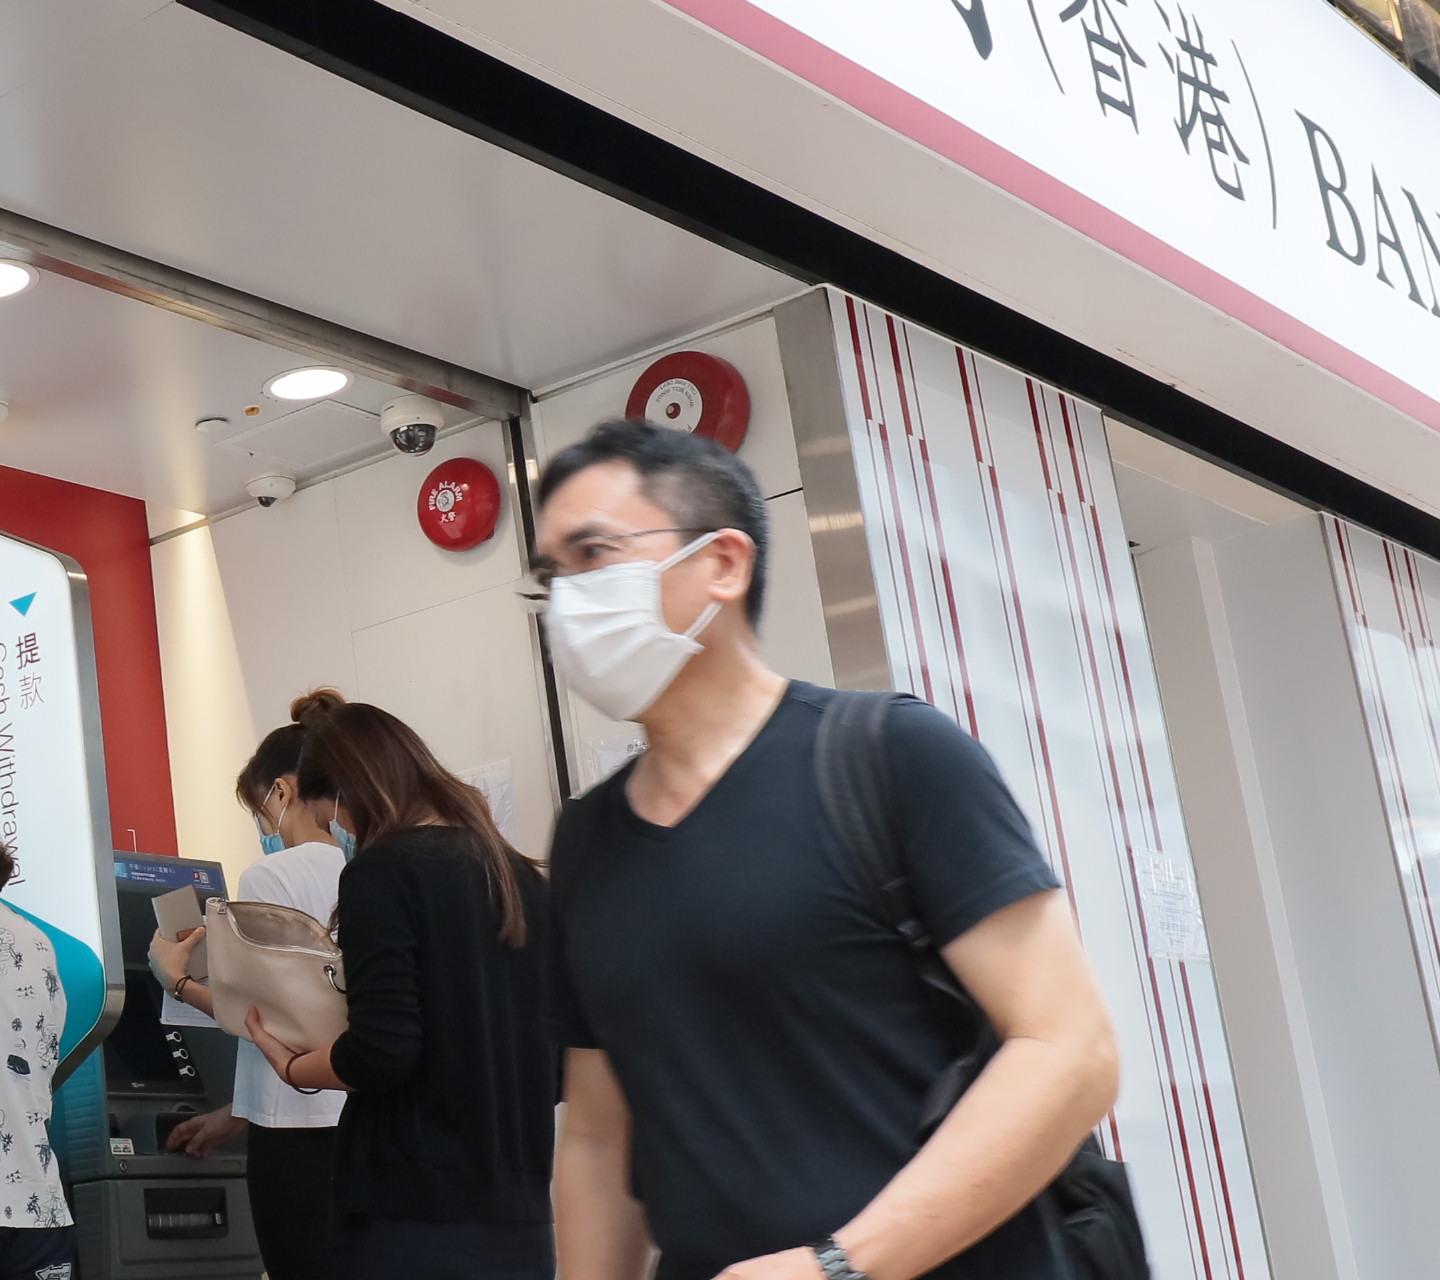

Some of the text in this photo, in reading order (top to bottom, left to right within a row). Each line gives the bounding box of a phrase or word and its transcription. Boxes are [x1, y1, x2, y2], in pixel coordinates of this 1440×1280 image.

[428, 480, 464, 511] FIRE ALARM
[15, 632, 45, 711] 提款
